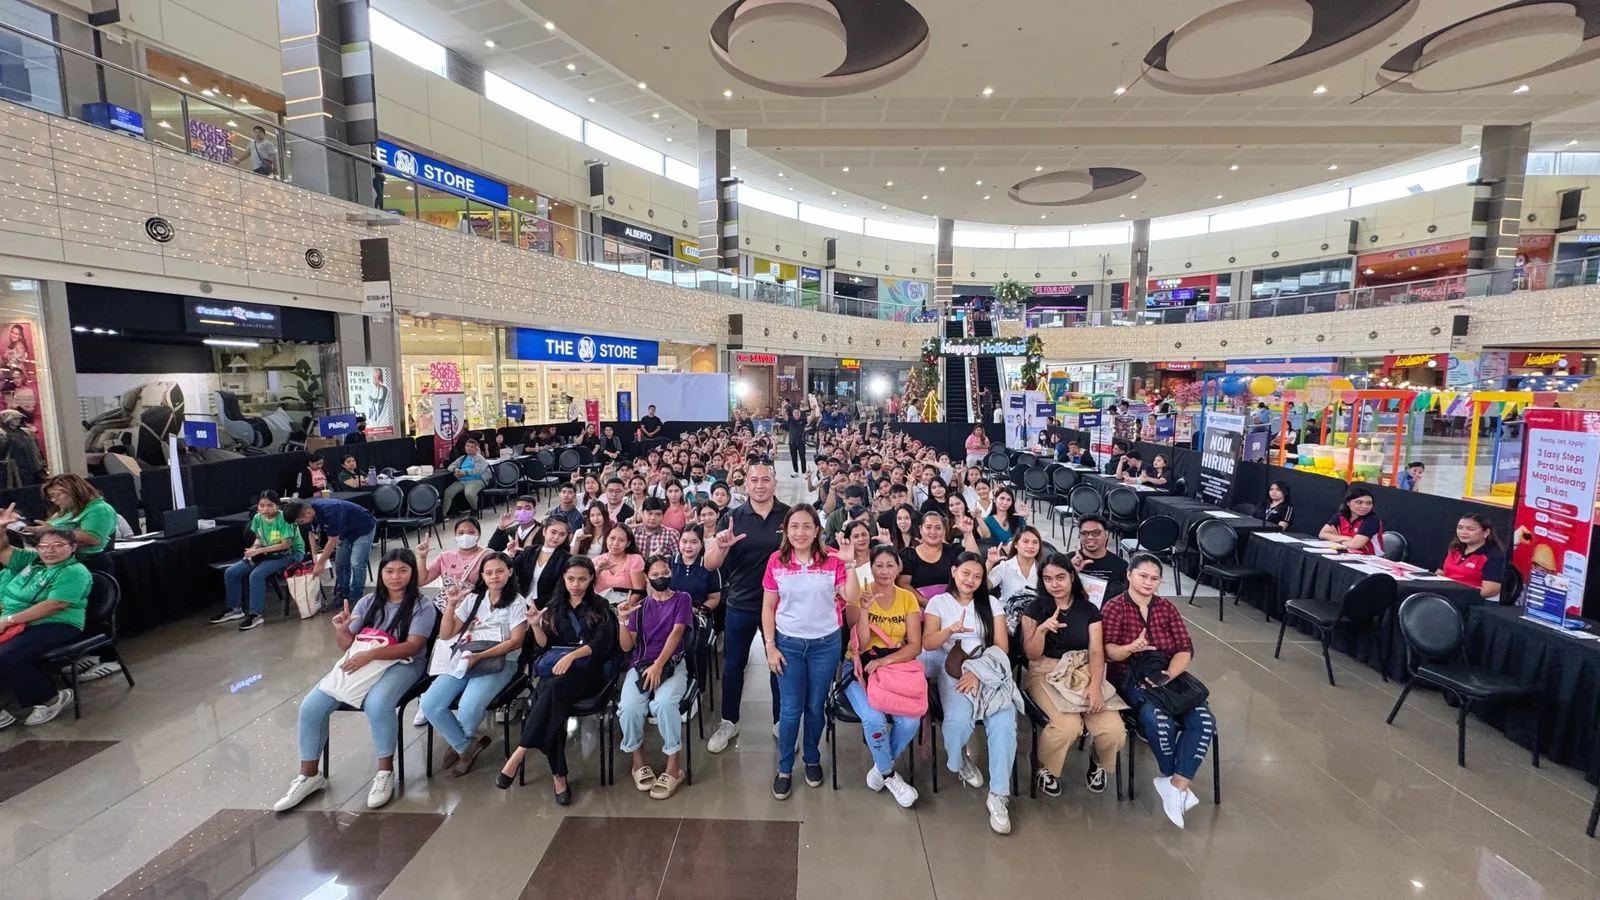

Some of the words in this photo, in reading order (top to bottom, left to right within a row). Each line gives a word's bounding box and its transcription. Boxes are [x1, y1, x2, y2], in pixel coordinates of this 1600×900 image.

[204, 142, 233, 158] YOUR
[424, 164, 475, 192] STORE
[625, 227, 653, 242] ALBERTO
[545, 339, 573, 355] THE
[599, 344, 638, 359] STORE
[941, 342, 980, 355] Happy
[980, 342, 1027, 355] Holidays
[430, 362, 458, 371] ACCES
[430, 370, 460, 380] SORIZE
[440, 379, 461, 388] YOUR
[196, 430, 207, 439] SSS
[1210, 435, 1232, 453] NOW
[1201, 452, 1235, 474] HIRING
[1537, 449, 1543, 457] 3
[1543, 449, 1560, 461] Easy
[1561, 452, 1585, 464] Steps
[1537, 460, 1554, 470] Para
[1555, 464, 1564, 472] sa
[1566, 465, 1583, 475] Mas
[1532, 471, 1586, 491] Maginhawang
[1545, 486, 1568, 497] Bukas
